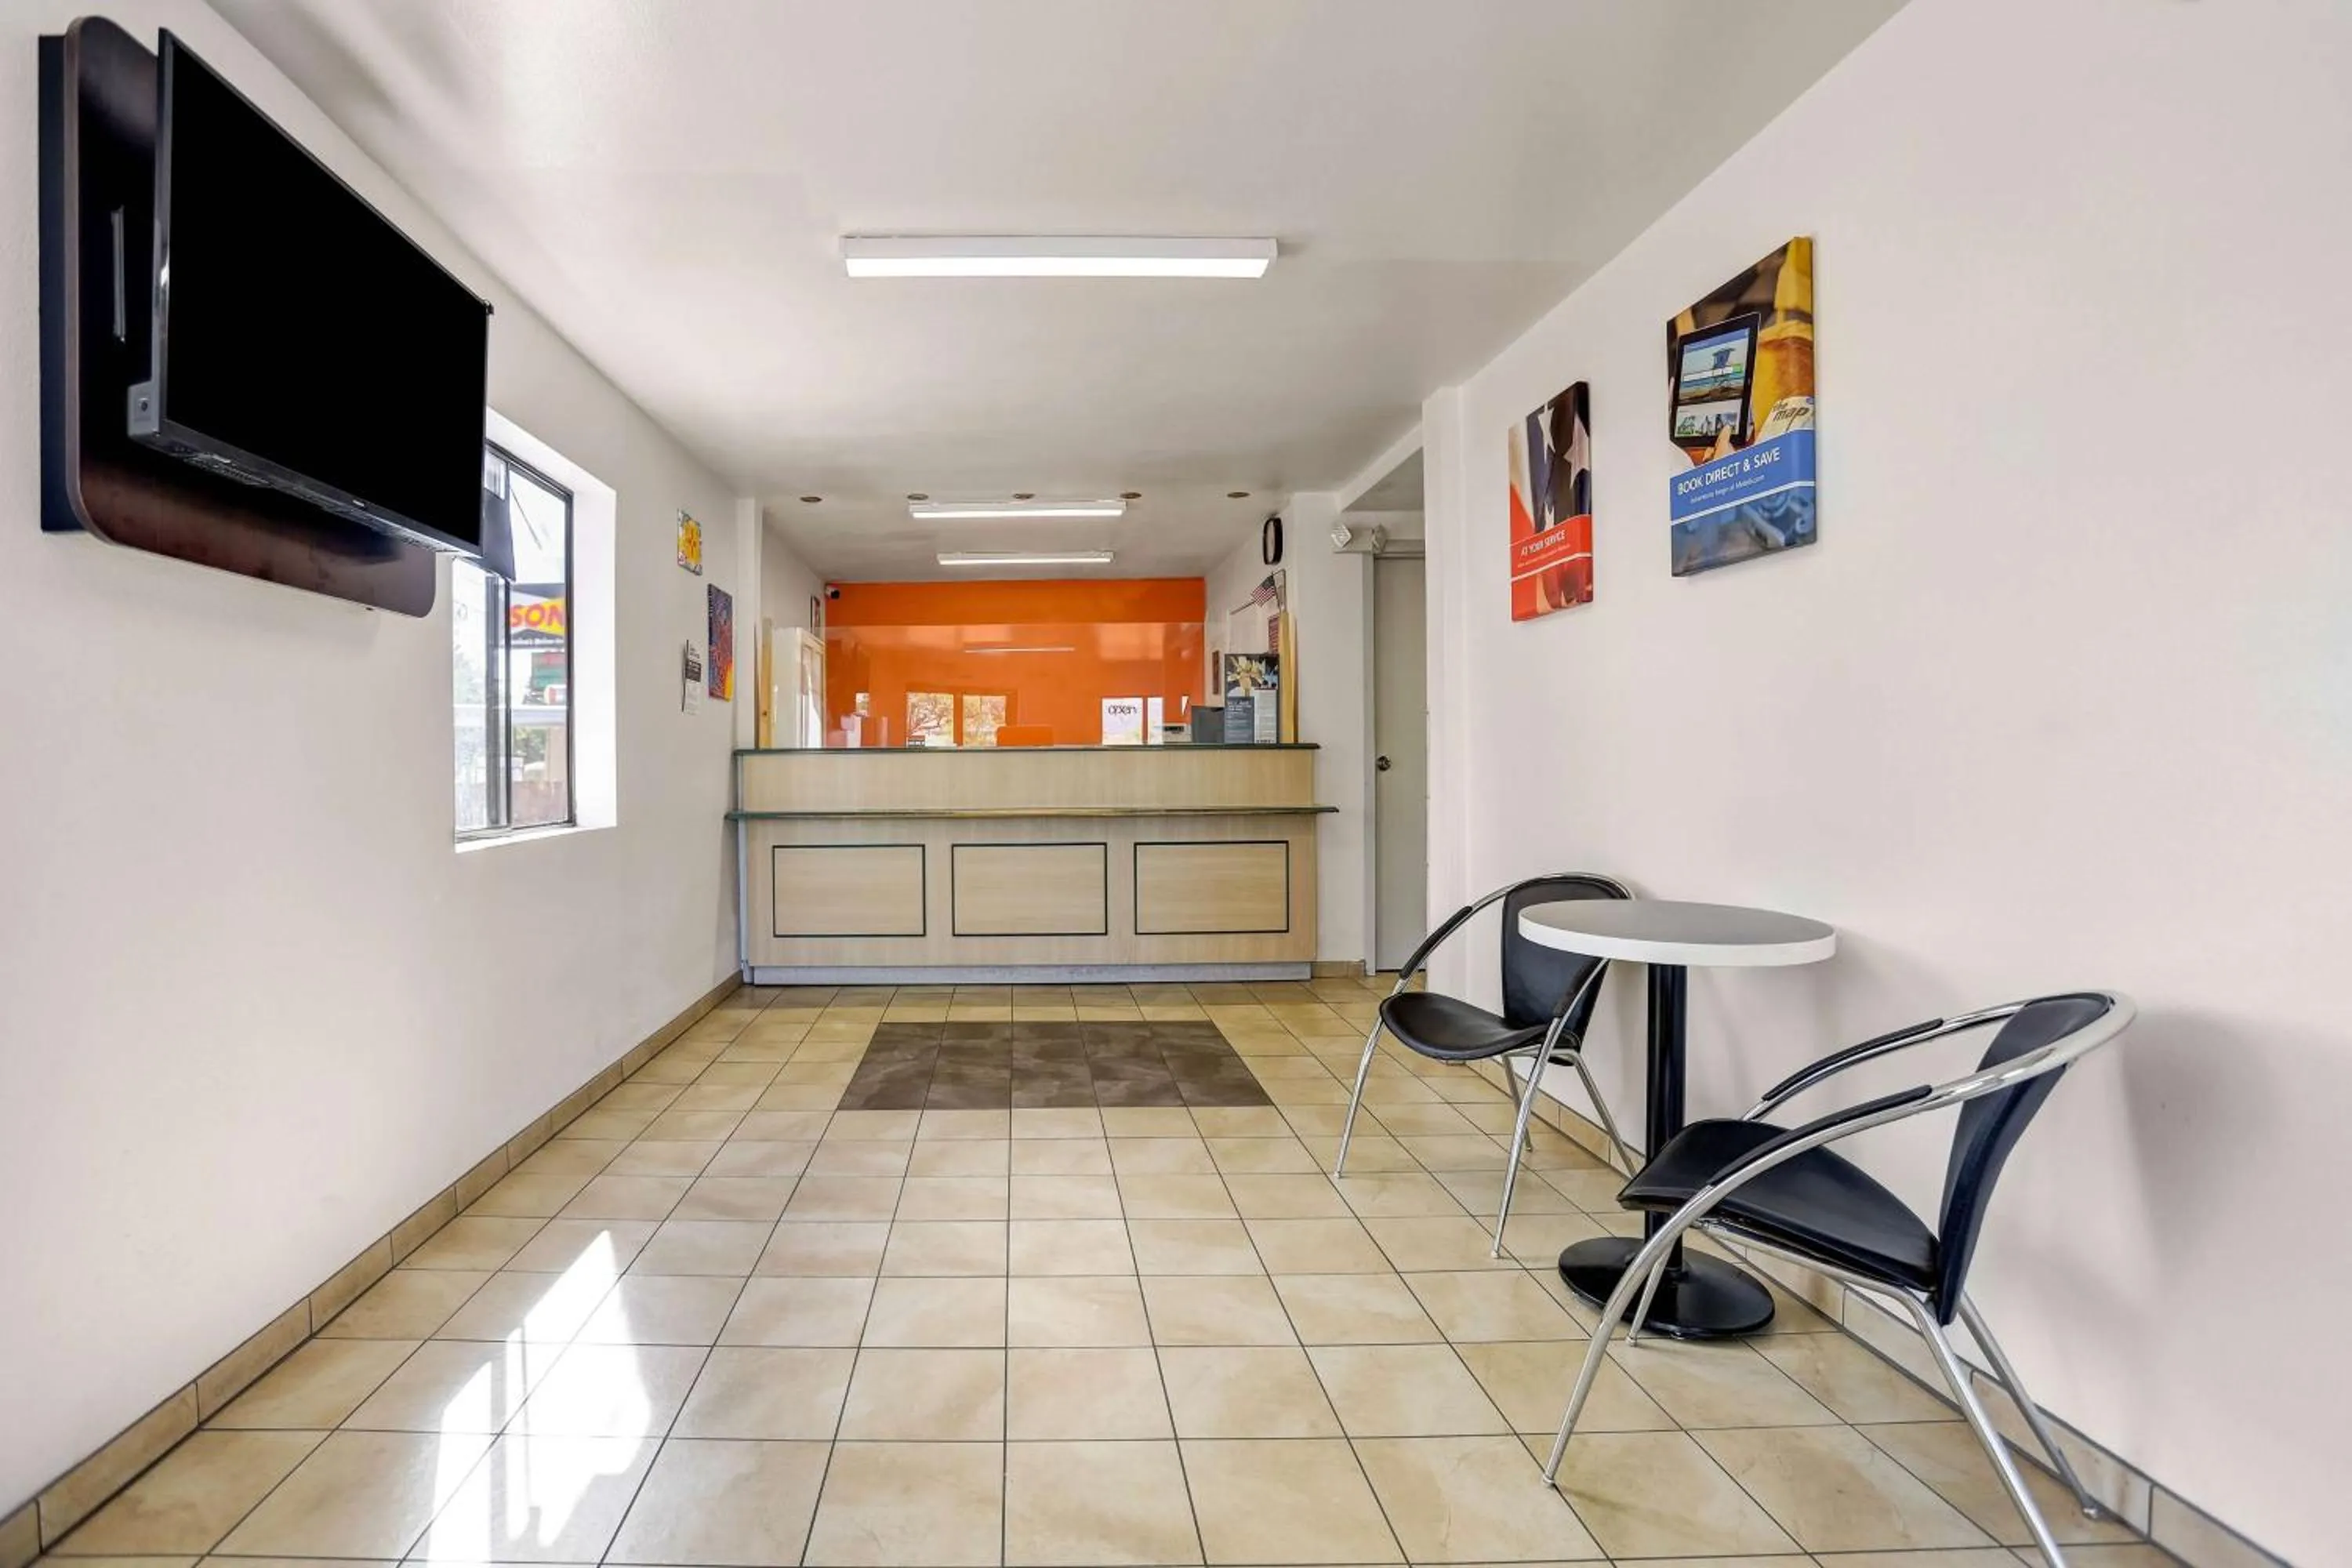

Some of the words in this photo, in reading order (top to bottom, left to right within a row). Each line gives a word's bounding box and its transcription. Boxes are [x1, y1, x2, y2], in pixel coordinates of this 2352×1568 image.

[1773, 407, 1809, 432] map
[1678, 475, 1704, 495] BOOK
[1705, 462, 1740, 485] DIRECT
[1743, 459, 1751, 472] &
[1754, 446, 1780, 468] SAVE
